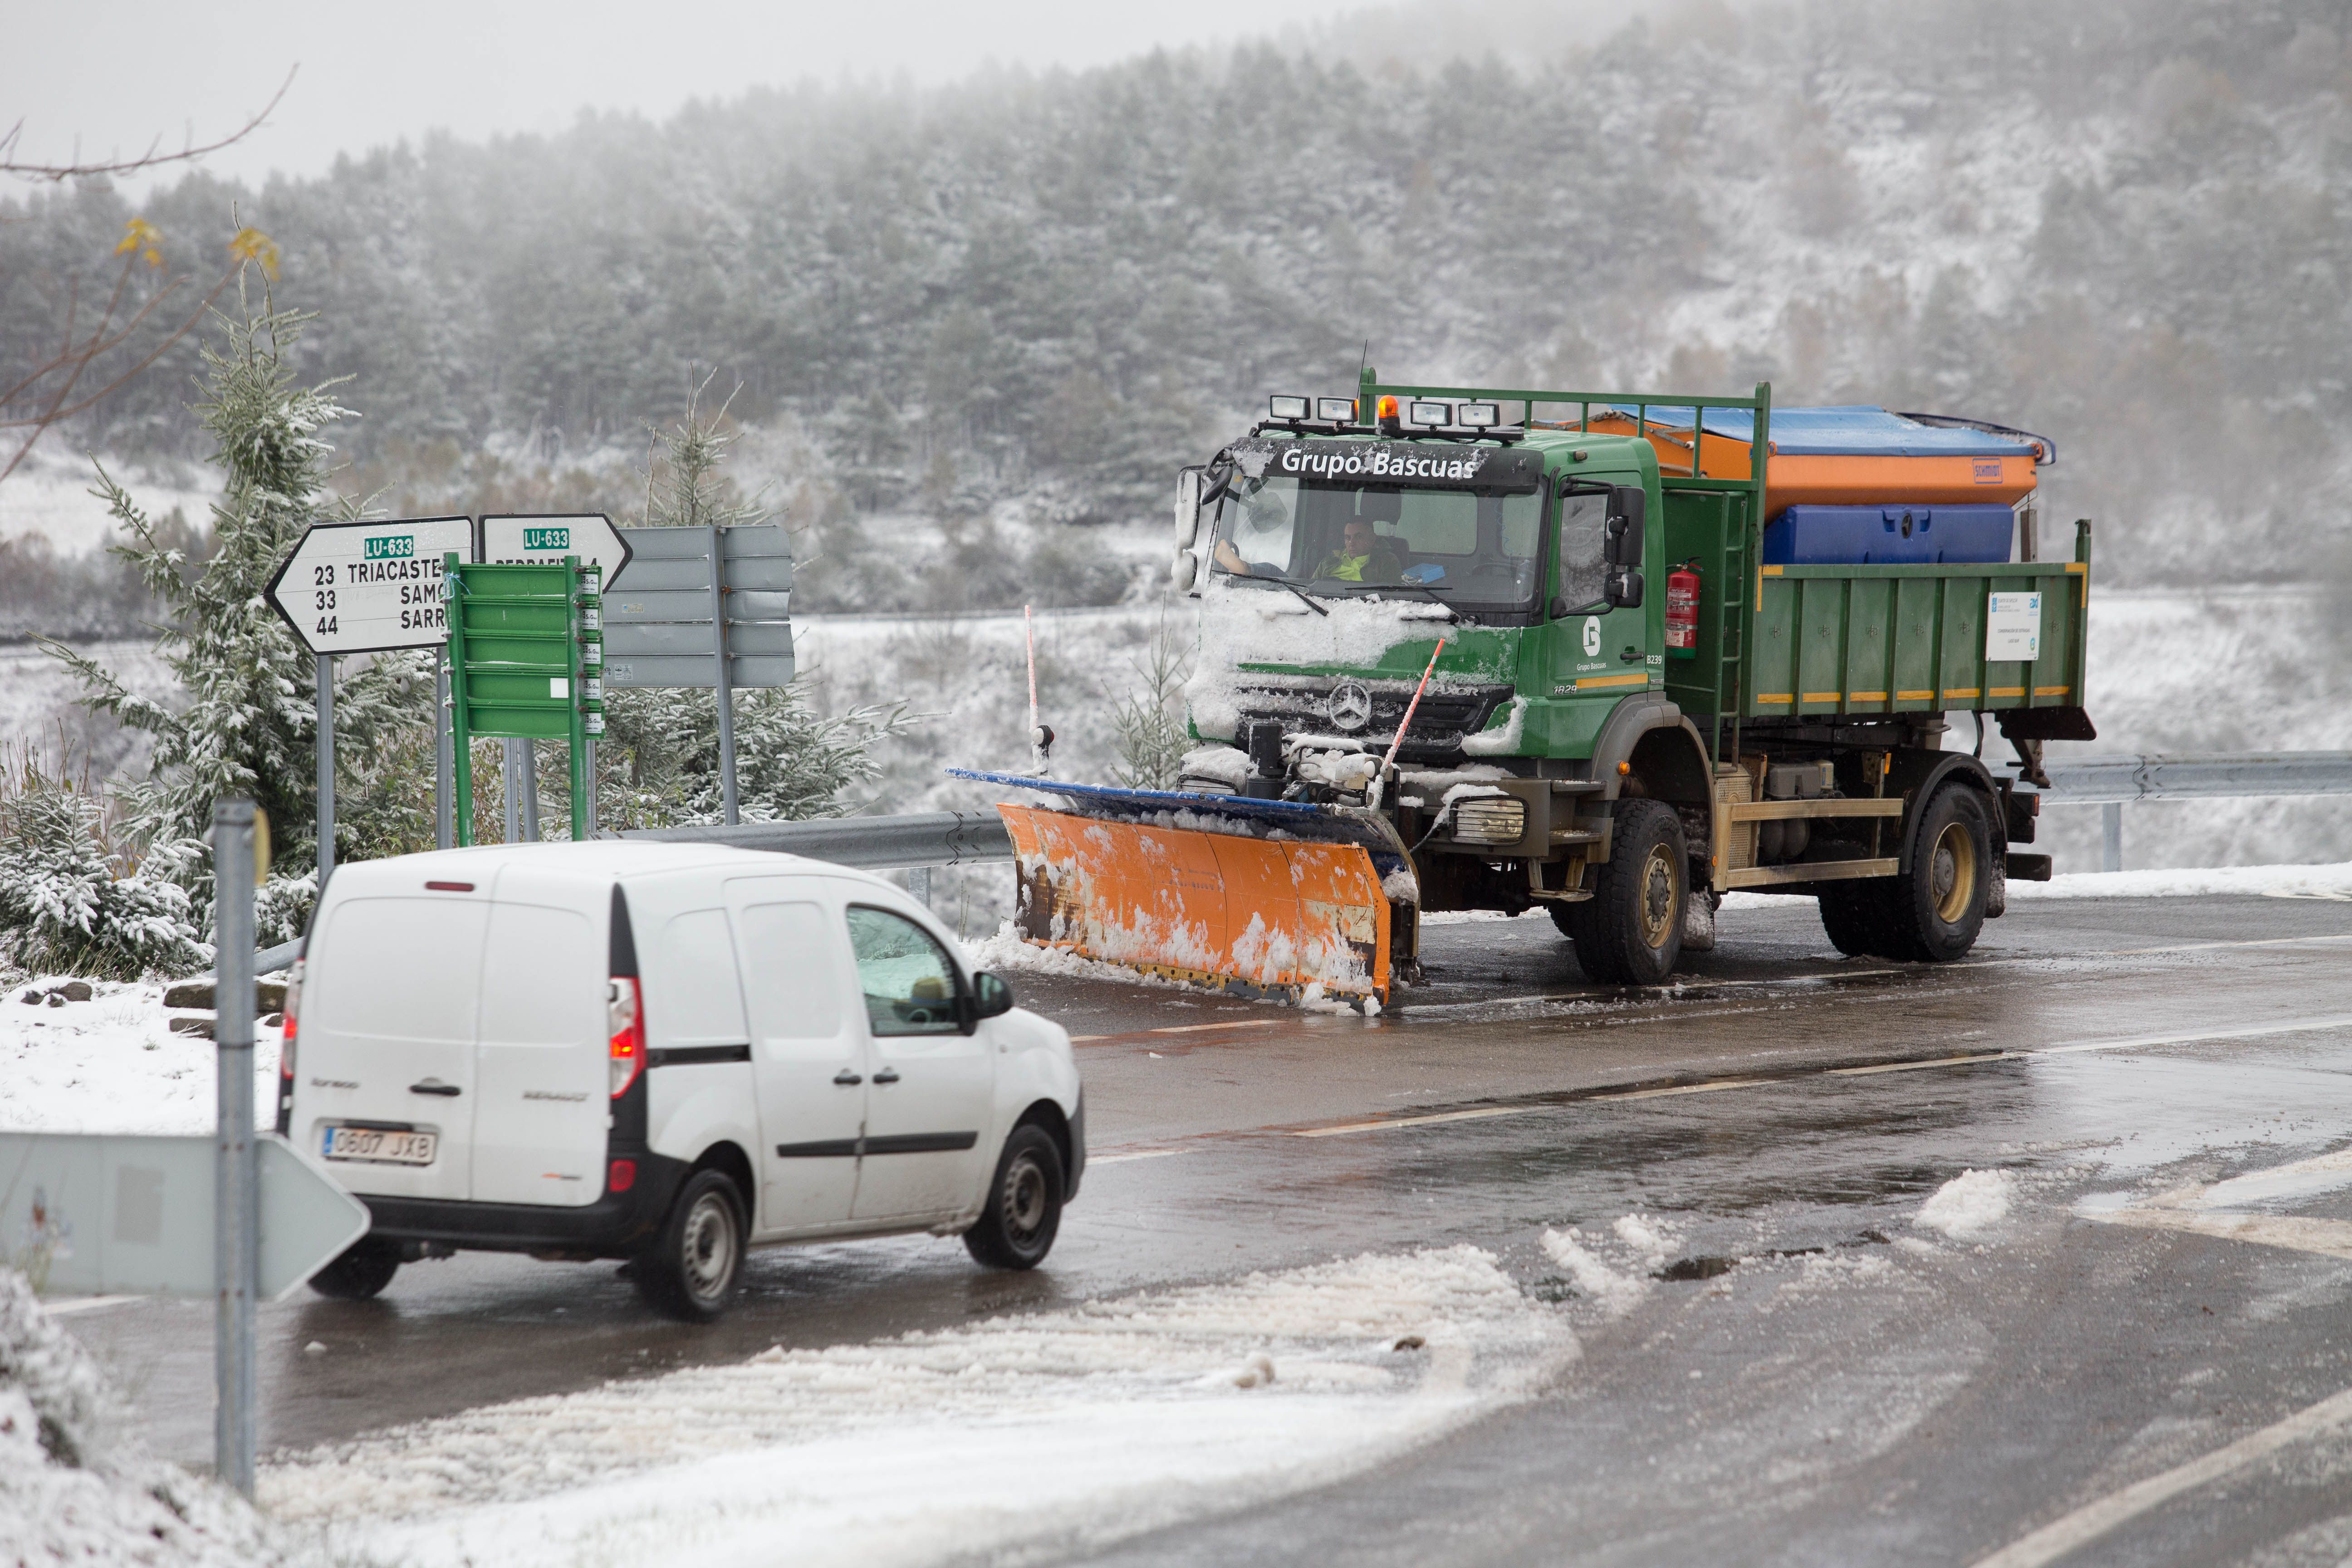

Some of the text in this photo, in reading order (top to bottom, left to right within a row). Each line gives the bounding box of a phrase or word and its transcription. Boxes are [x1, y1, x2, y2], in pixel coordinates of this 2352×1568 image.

[1282, 449, 1476, 479] Grupo Bascuas
[365, 538, 413, 557] LU-633
[524, 530, 568, 547] LU-633
[314, 558, 441, 586] 23 TRIACASTE
[316, 590, 336, 611] 33
[316, 608, 445, 636] 44 SARR
[1577, 663, 1590, 671] Grupo
[1646, 655, 1662, 664] B239
[1553, 685, 1577, 695] 1829
[337, 1132, 429, 1158] 0607 JXB
